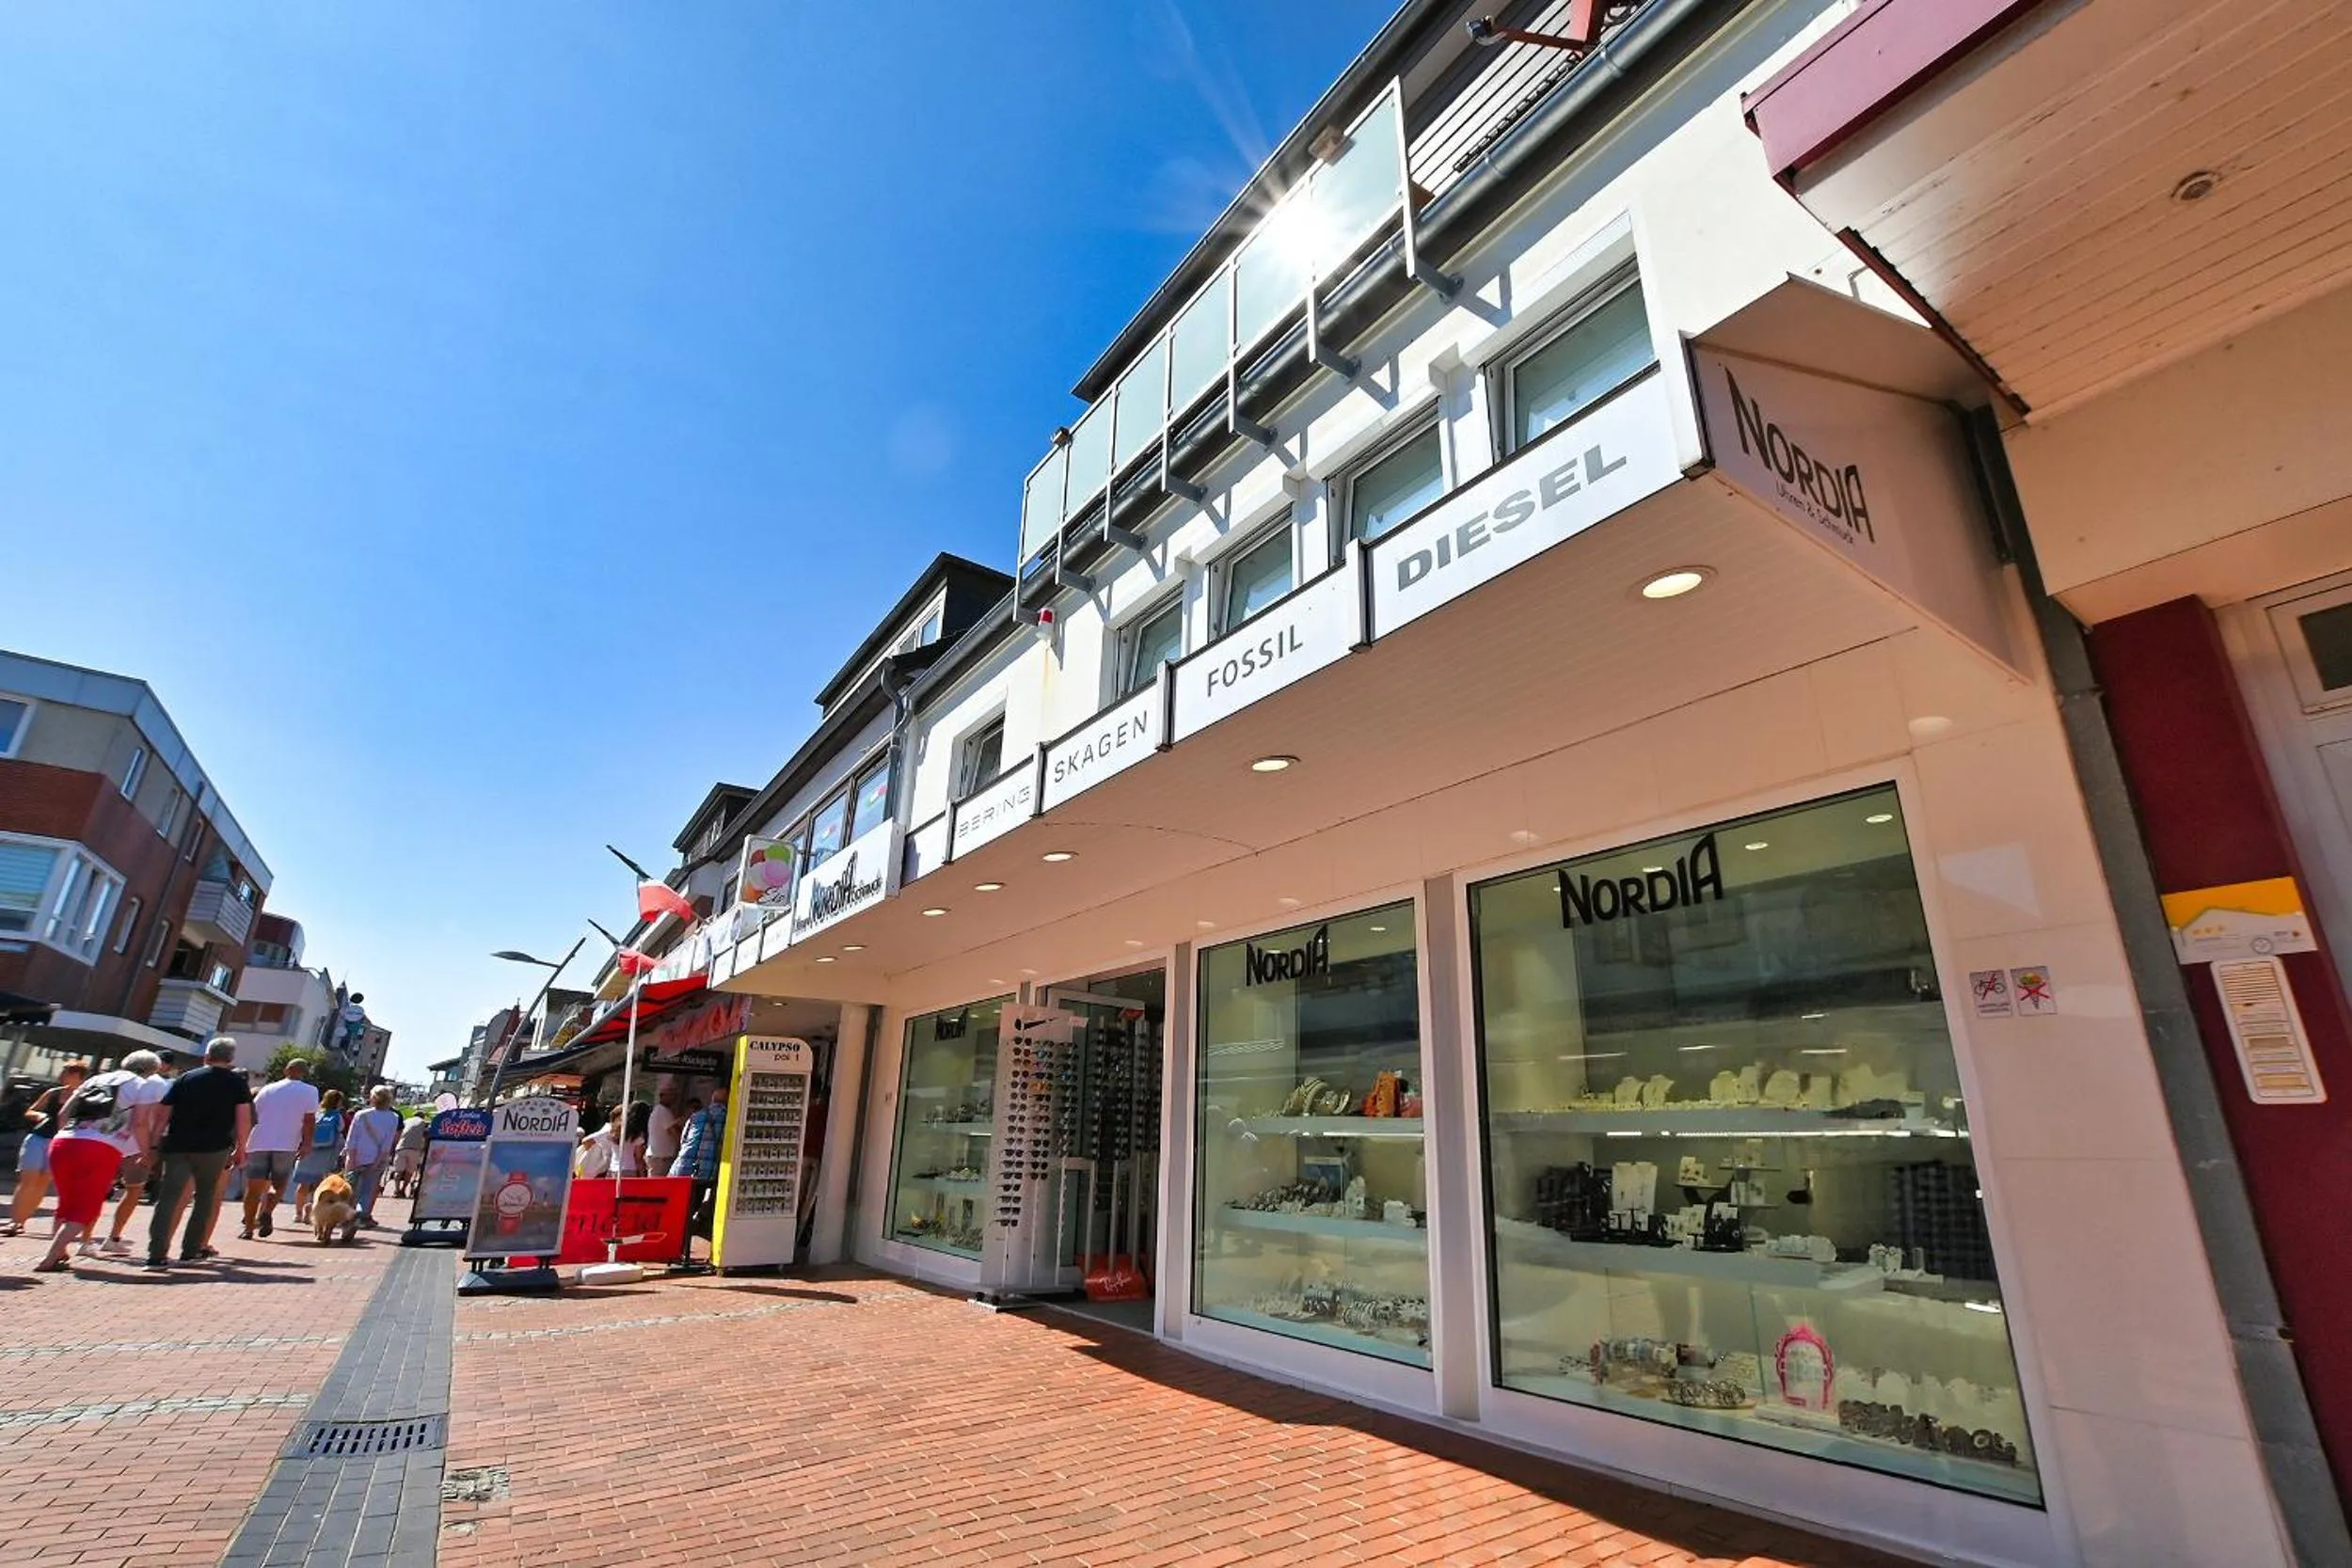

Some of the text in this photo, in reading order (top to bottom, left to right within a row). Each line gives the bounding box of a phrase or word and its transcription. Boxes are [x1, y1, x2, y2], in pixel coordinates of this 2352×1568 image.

[1724, 366, 1875, 544] NORDIA
[1397, 444, 1627, 592] DIESEL
[1207, 625, 1304, 698] FOSSIL
[1054, 710, 1148, 784] SKAGEN
[958, 785, 1031, 838] BERING
[1558, 833, 1724, 928] NORDIA
[1247, 924, 1329, 987] NORDIA
[750, 1040, 800, 1052] CALYPSO
[502, 1108, 570, 1132] NORDIA
